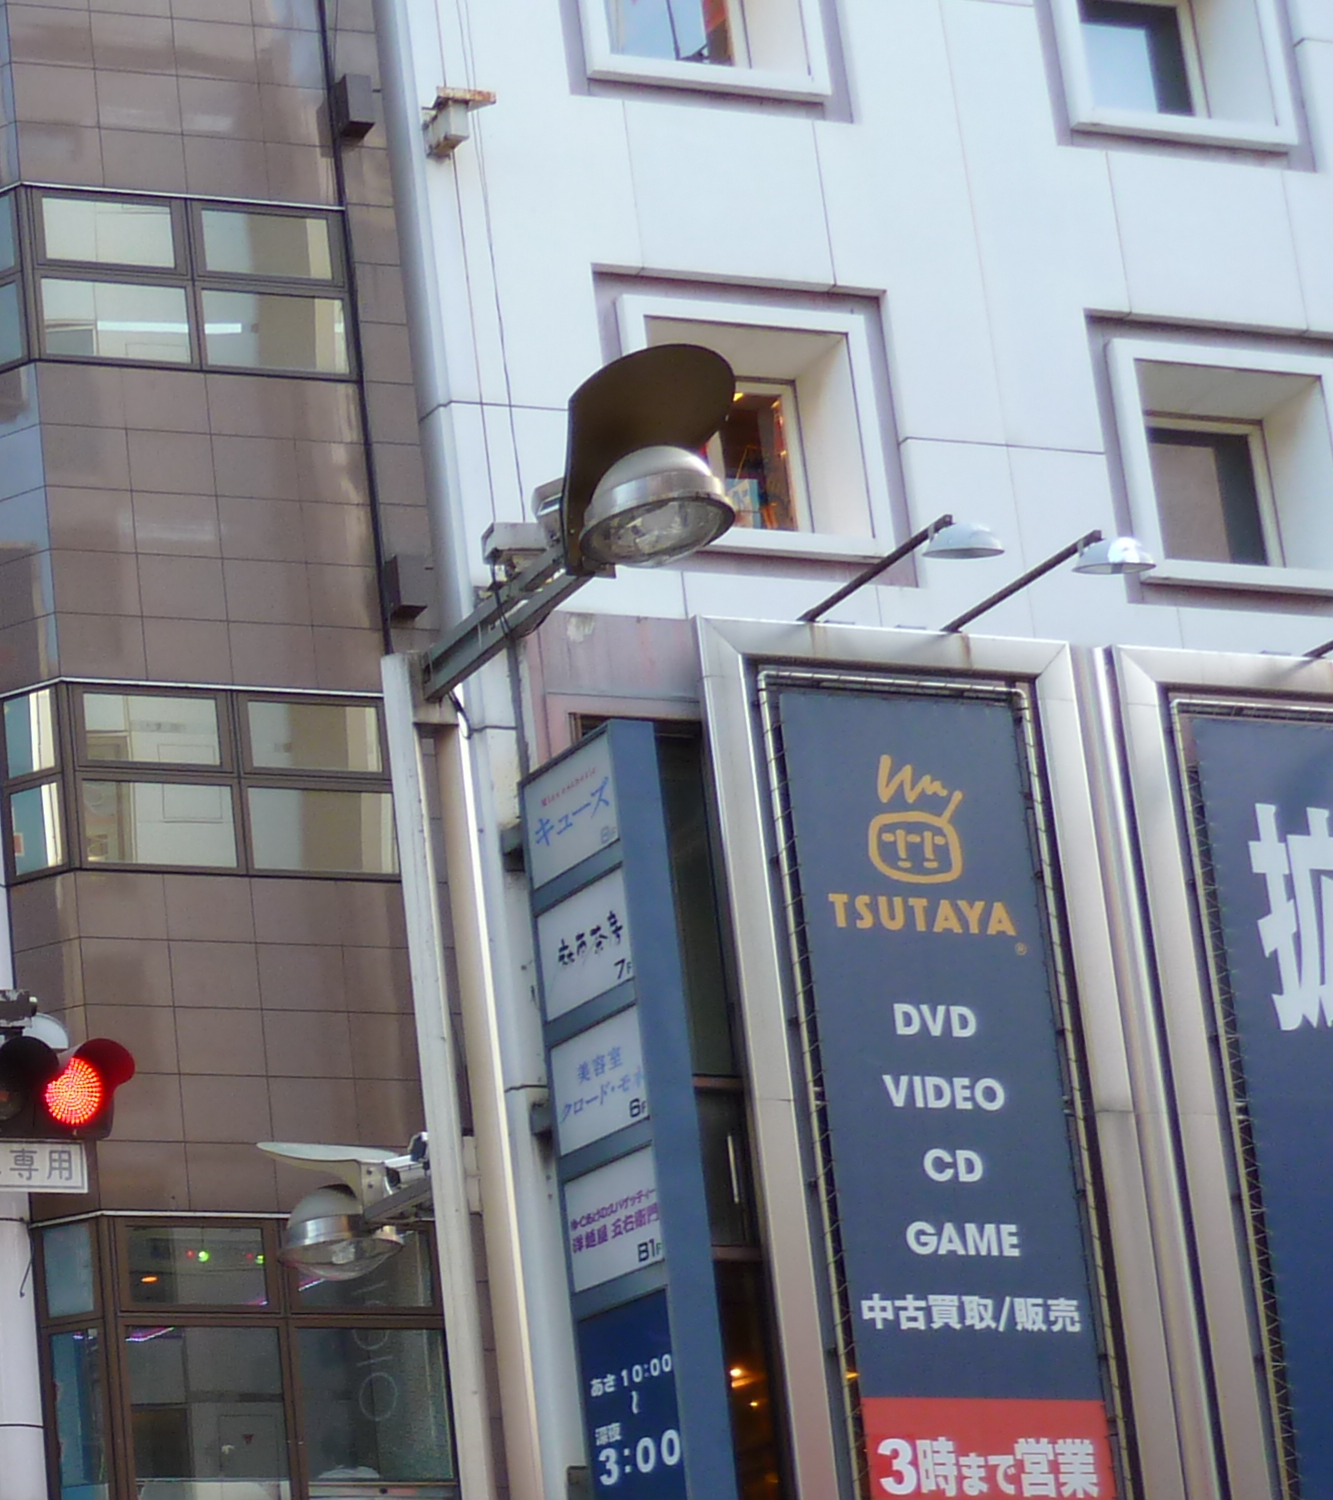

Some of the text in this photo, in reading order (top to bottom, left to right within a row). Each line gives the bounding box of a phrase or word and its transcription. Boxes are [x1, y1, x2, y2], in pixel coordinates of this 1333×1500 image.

[535, 776, 610, 847] キューズ
[828, 893, 1017, 936] TSUTAYA
[614, 959, 633, 981] 7F
[893, 1003, 977, 1038] DVD
[576, 1046, 624, 1086] 美容室
[629, 1098, 648, 1118] 6F
[882, 1074, 1005, 1111] VIDEO
[923, 1148, 984, 1182] CD
[906, 1222, 1021, 1257] GAME
[860, 1293, 1082, 1333] 中古買取/販売
[590, 1352, 673, 1399] あさ 10:00
[595, 1420, 622, 1446] 深夜
[598, 1428, 681, 1486] 3:00
[877, 1437, 1099, 1499] 3時まで営業
